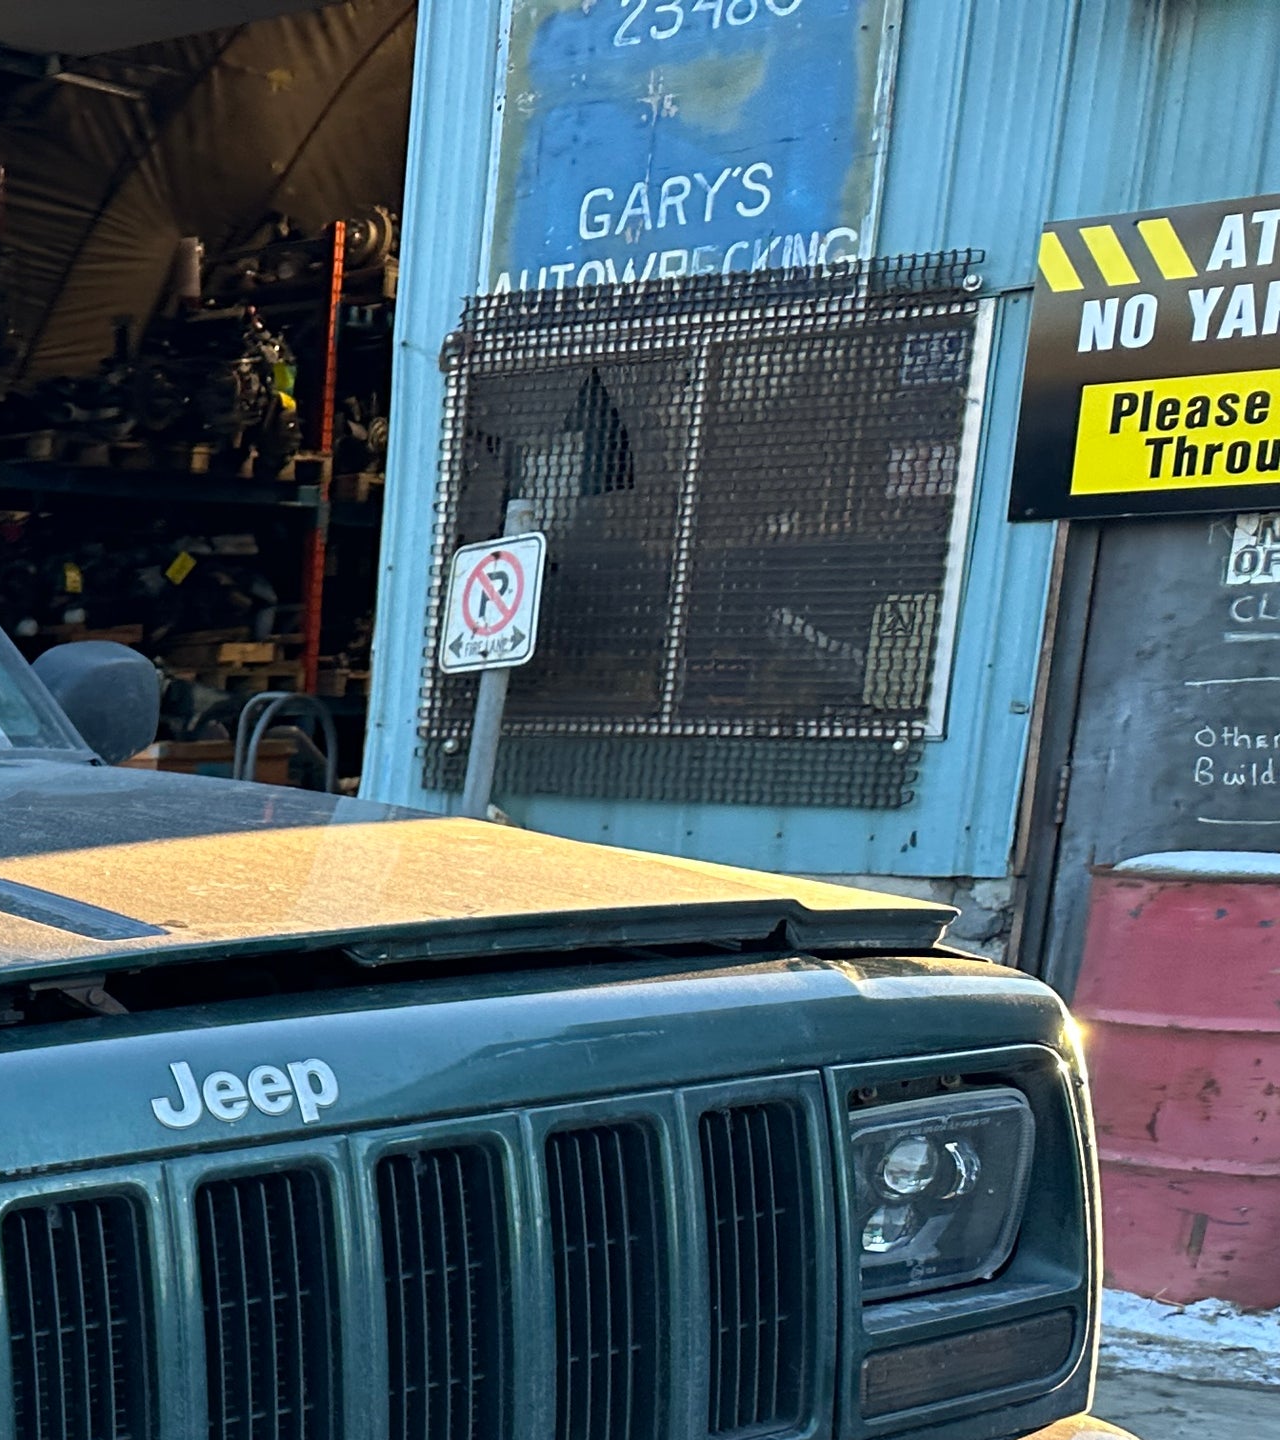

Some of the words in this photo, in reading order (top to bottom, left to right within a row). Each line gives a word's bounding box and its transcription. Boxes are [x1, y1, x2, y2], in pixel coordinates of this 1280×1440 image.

[579, 162, 773, 240] GARY'S
[1077, 293, 1158, 353] NO
[1109, 390, 1271, 435] Please
[1145, 435, 1280, 479] Throu
[151, 1058, 339, 1130] Jeep
